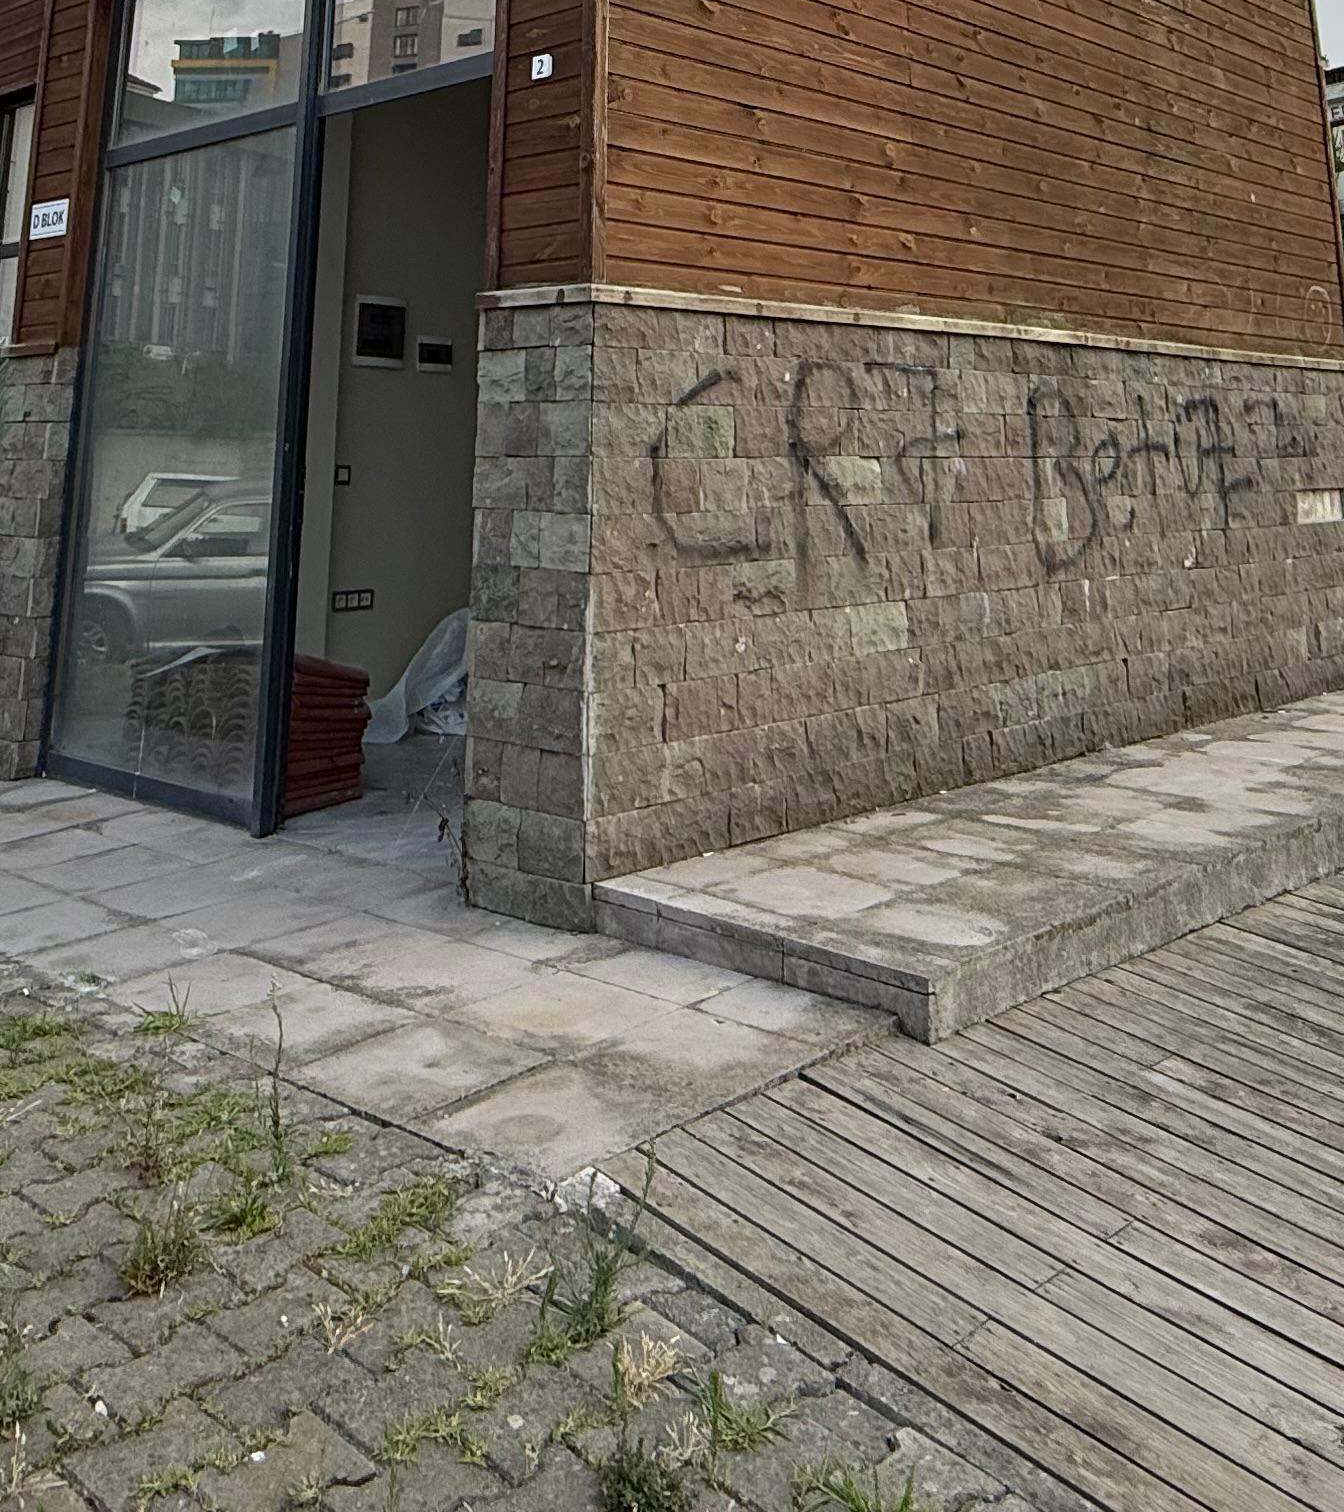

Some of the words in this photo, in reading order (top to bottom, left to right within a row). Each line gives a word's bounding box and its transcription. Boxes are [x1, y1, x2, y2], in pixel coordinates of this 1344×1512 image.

[536, 58, 544, 76] 2
[33, 214, 40, 229] D
[41, 210, 64, 228] BLOK
